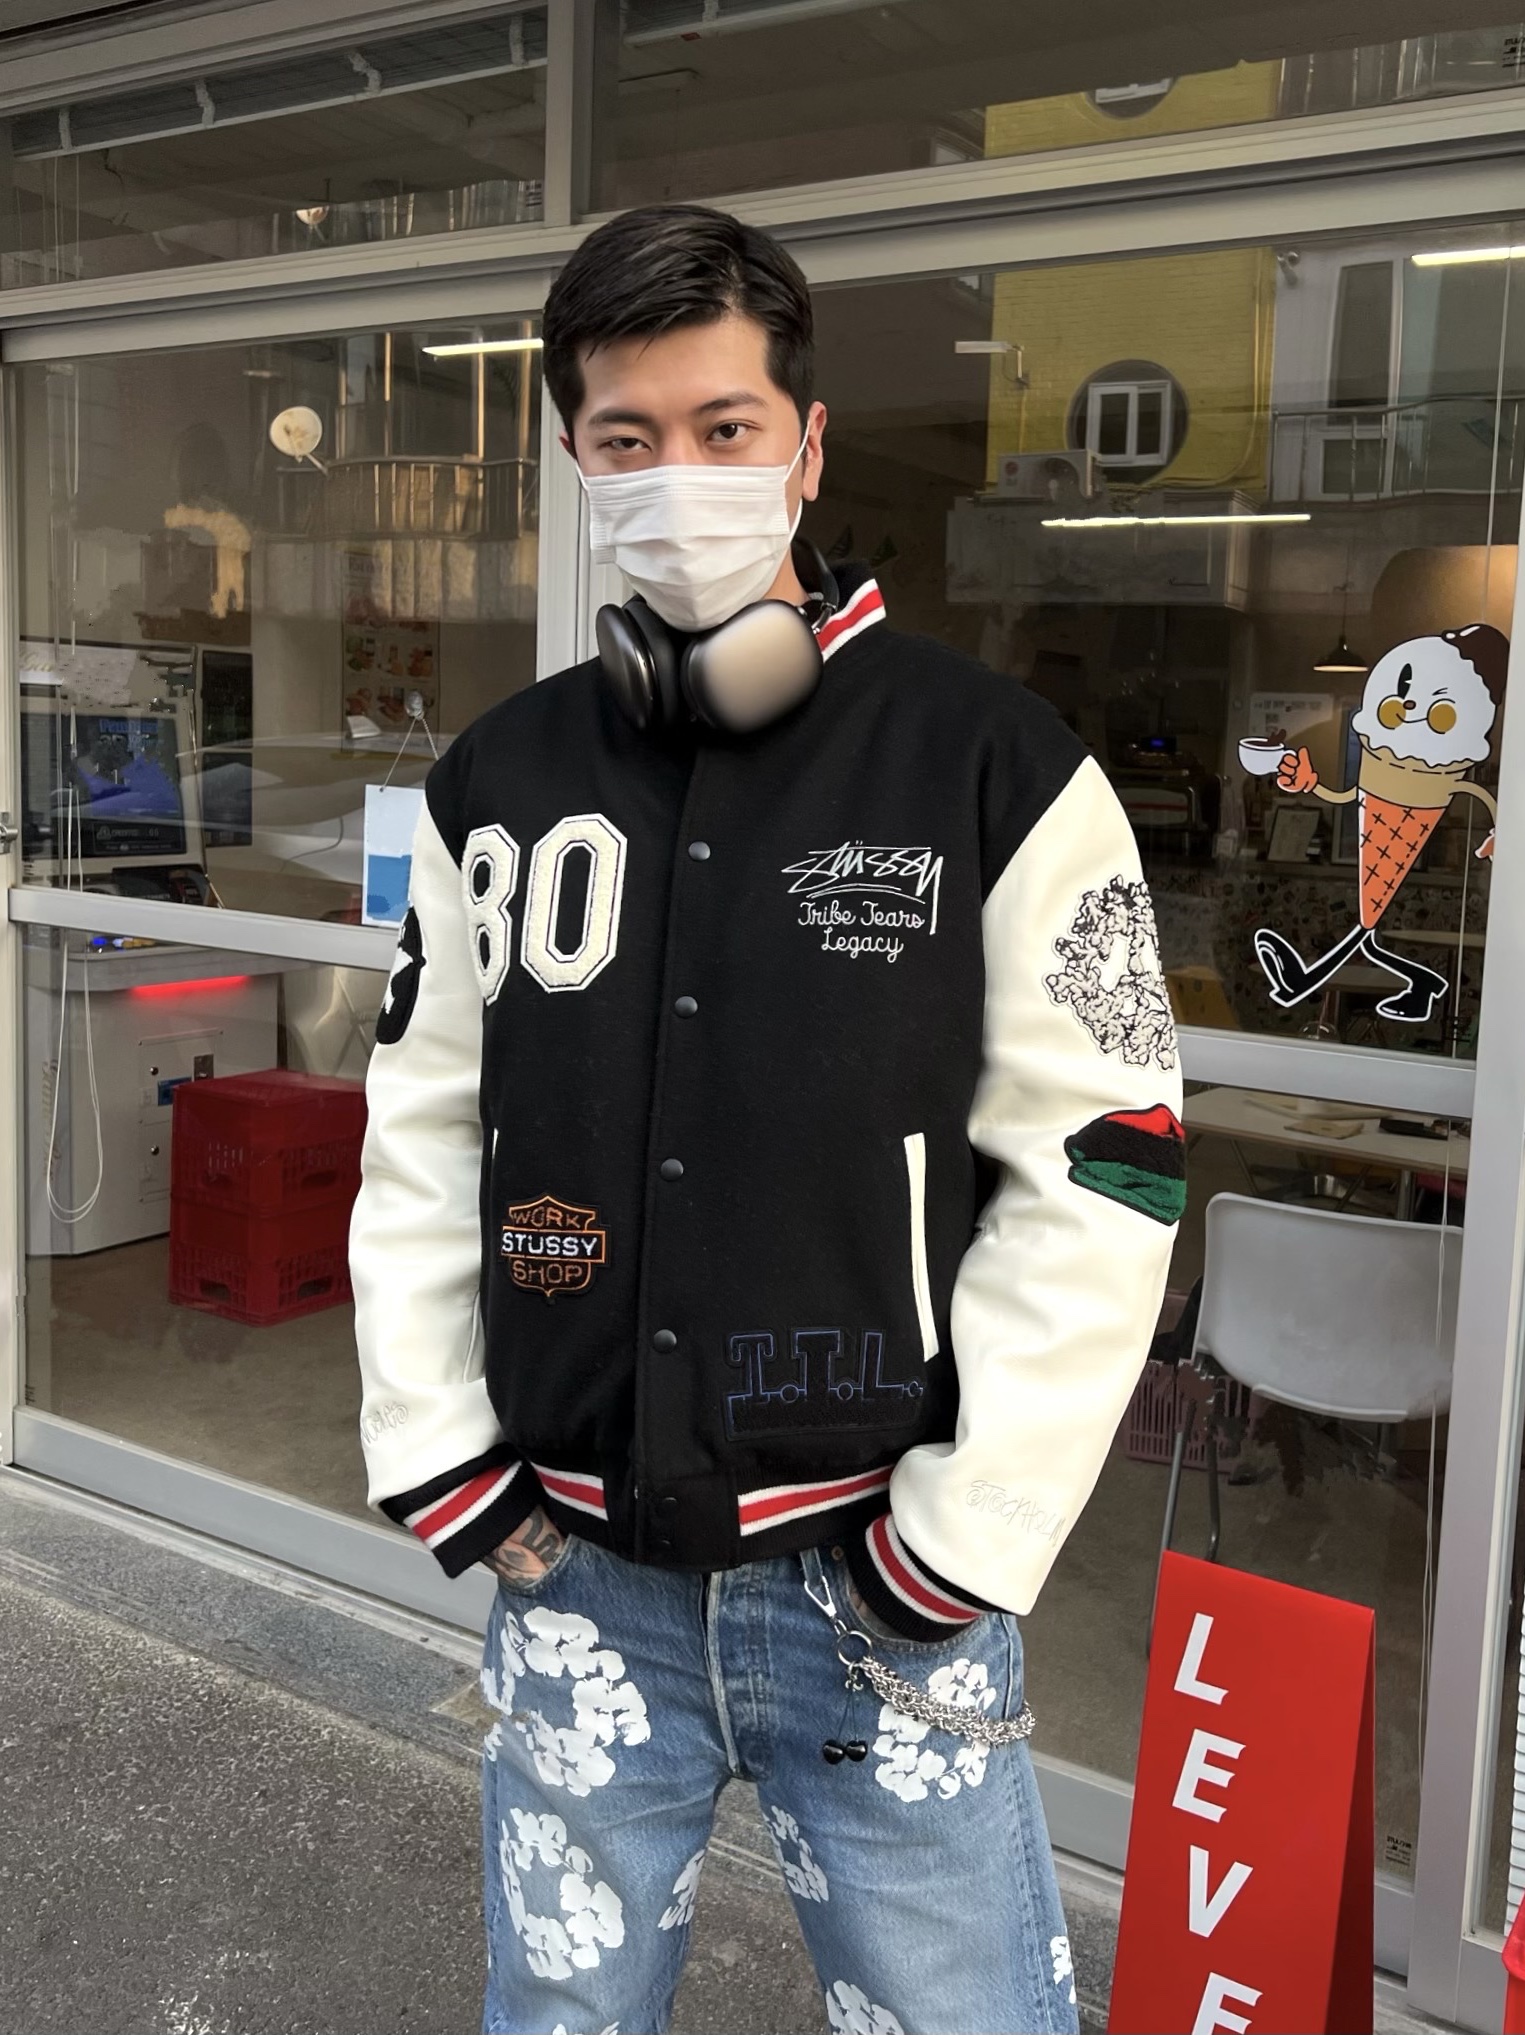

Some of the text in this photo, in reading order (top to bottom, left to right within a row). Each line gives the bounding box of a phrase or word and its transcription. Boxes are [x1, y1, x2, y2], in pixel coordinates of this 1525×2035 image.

[461, 813, 628, 1006] 80
[798, 899, 926, 929] Tribe Tears
[821, 926, 904, 963] Legacy
[512, 1206, 581, 1229] WORK
[501, 1231, 598, 1256] STUSSY
[512, 1260, 583, 1285] SHOP
